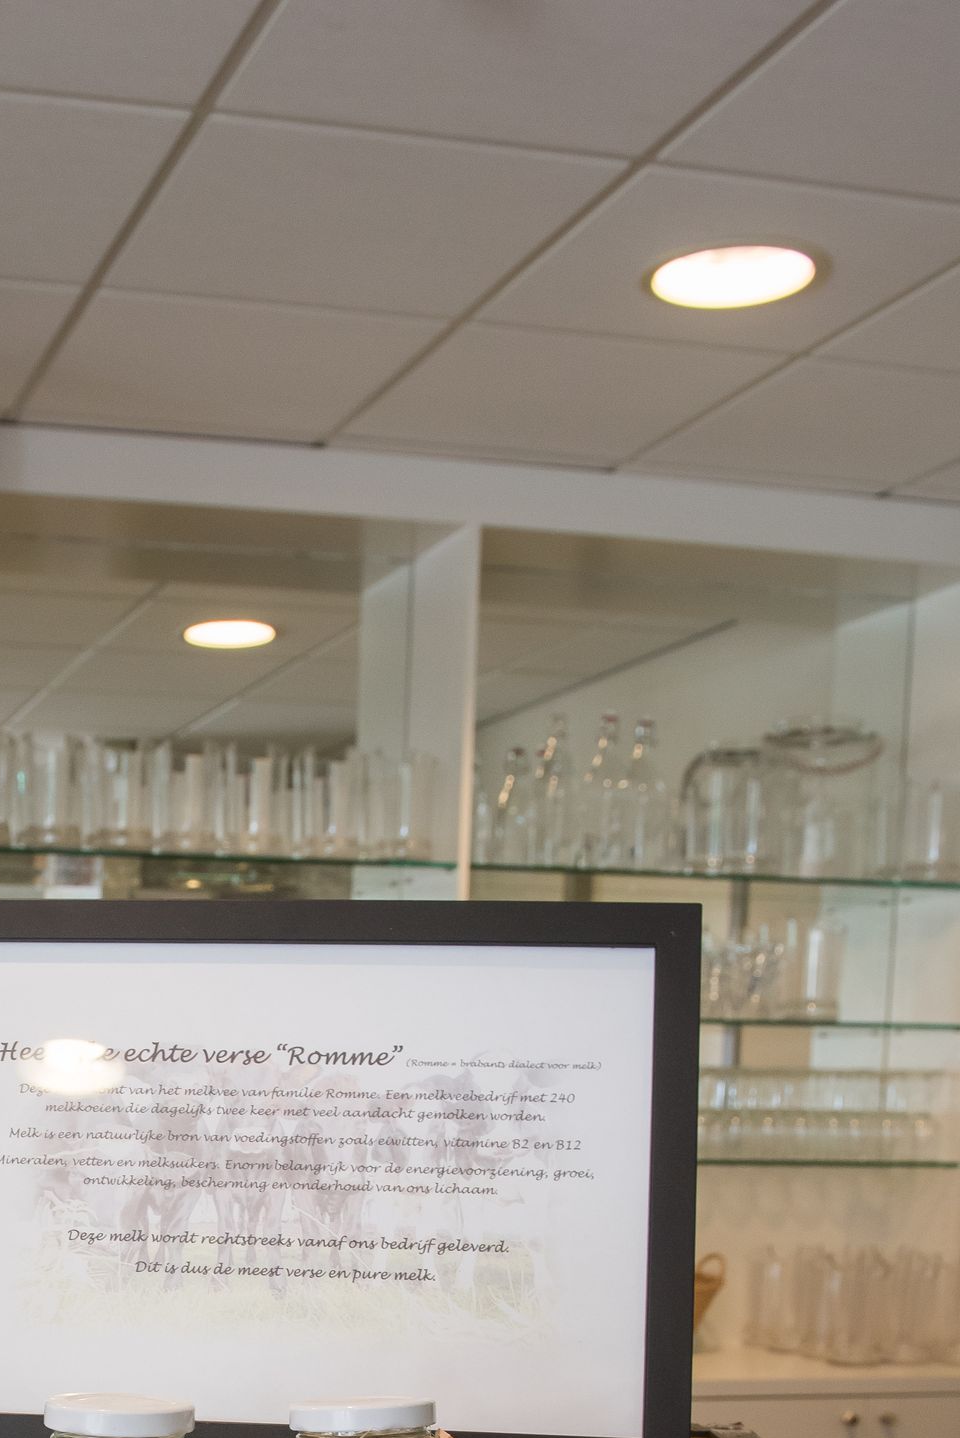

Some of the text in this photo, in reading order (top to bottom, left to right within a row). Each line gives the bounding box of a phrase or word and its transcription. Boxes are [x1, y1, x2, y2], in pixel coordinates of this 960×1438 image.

[124, 1042, 199, 1063] echte
[203, 1048, 272, 1065] verse
[276, 1043, 404, 1066] “Romme”
[406, 1058, 449, 1068] (Romme
[508, 1060, 545, 1070] dialect
[129, 1086, 156, 1097] van
[158, 1085, 182, 1096] het
[184, 1086, 239, 1098] melkvee
[242, 1087, 268, 1098] van
[268, 1086, 323, 1101] familie
[325, 1088, 380, 1100] Romme.
[386, 1090, 413, 1100] Een
[415, 1090, 519, 1105] melkveebedrijf
[520, 1092, 548, 1103] met
[550, 1093, 575, 1103] 240
[46, 1102, 546, 1122] melkkoeien die dagelijks twee keer met veel aandacht gemolken worden.
[9, 1128, 582, 1150] Melk is een natuurlijke bron van voedingstoffen zoals eiwitten, vitamine B2 en B12
[72, 1156, 116, 1167] vetten
[116, 1158, 135, 1167] en
[138, 1157, 220, 1169] melksuikers.
[225, 1158, 273, 1170] Enorm
[274, 1159, 348, 1173] belangrijk
[350, 1164, 382, 1174] voor
[384, 1162, 403, 1174] de
[406, 1164, 549, 1181] energievoorziening,
[553, 1167, 595, 1181] groei,
[83, 1175, 499, 1195] ontwikkeling, bescherming en onderhoud van ons lichaam.
[67, 1228, 510, 1255] Deze melk wordt rechtstreeks vanaf ons bedrijf geleverd.
[135, 1260, 437, 1284] Dit is dus de meest verse en pure melk.
